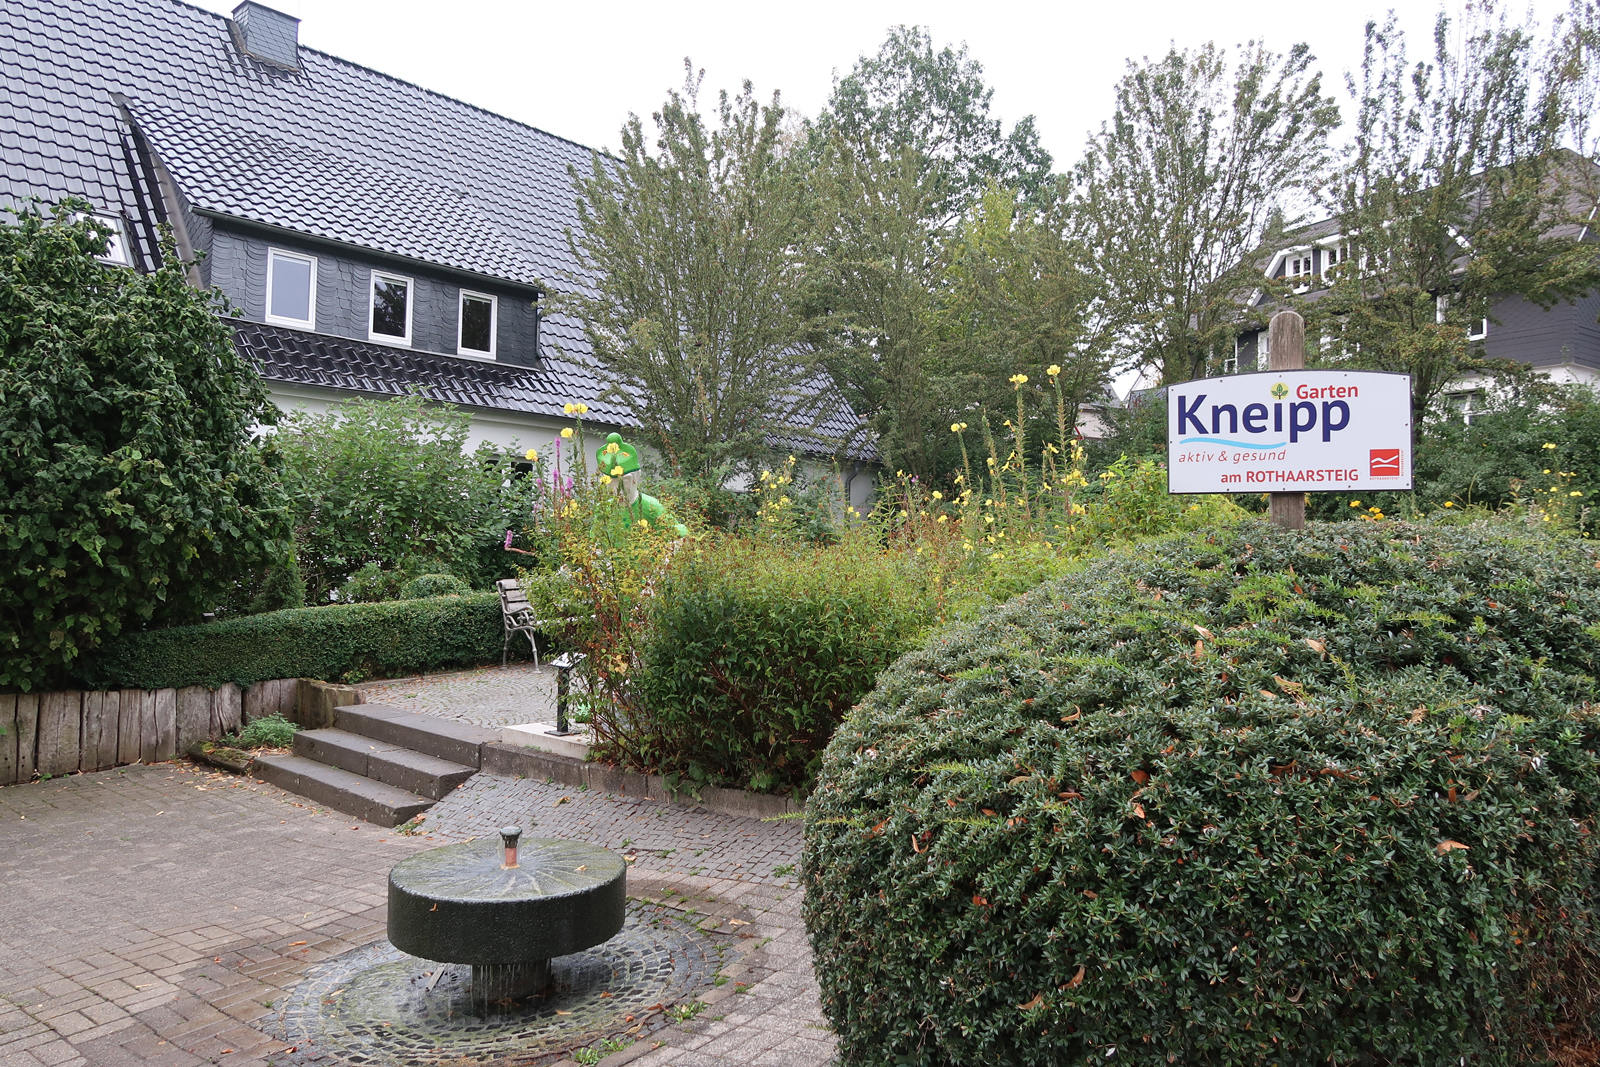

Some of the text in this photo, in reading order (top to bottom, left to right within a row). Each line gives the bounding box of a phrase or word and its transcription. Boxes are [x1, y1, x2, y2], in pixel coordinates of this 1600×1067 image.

[1296, 384, 1359, 399] Garten
[1178, 394, 1351, 443] Kneipp
[1178, 449, 1287, 465] aktiv & gesund
[1220, 469, 1359, 483] am ROTHAARSTEIG
